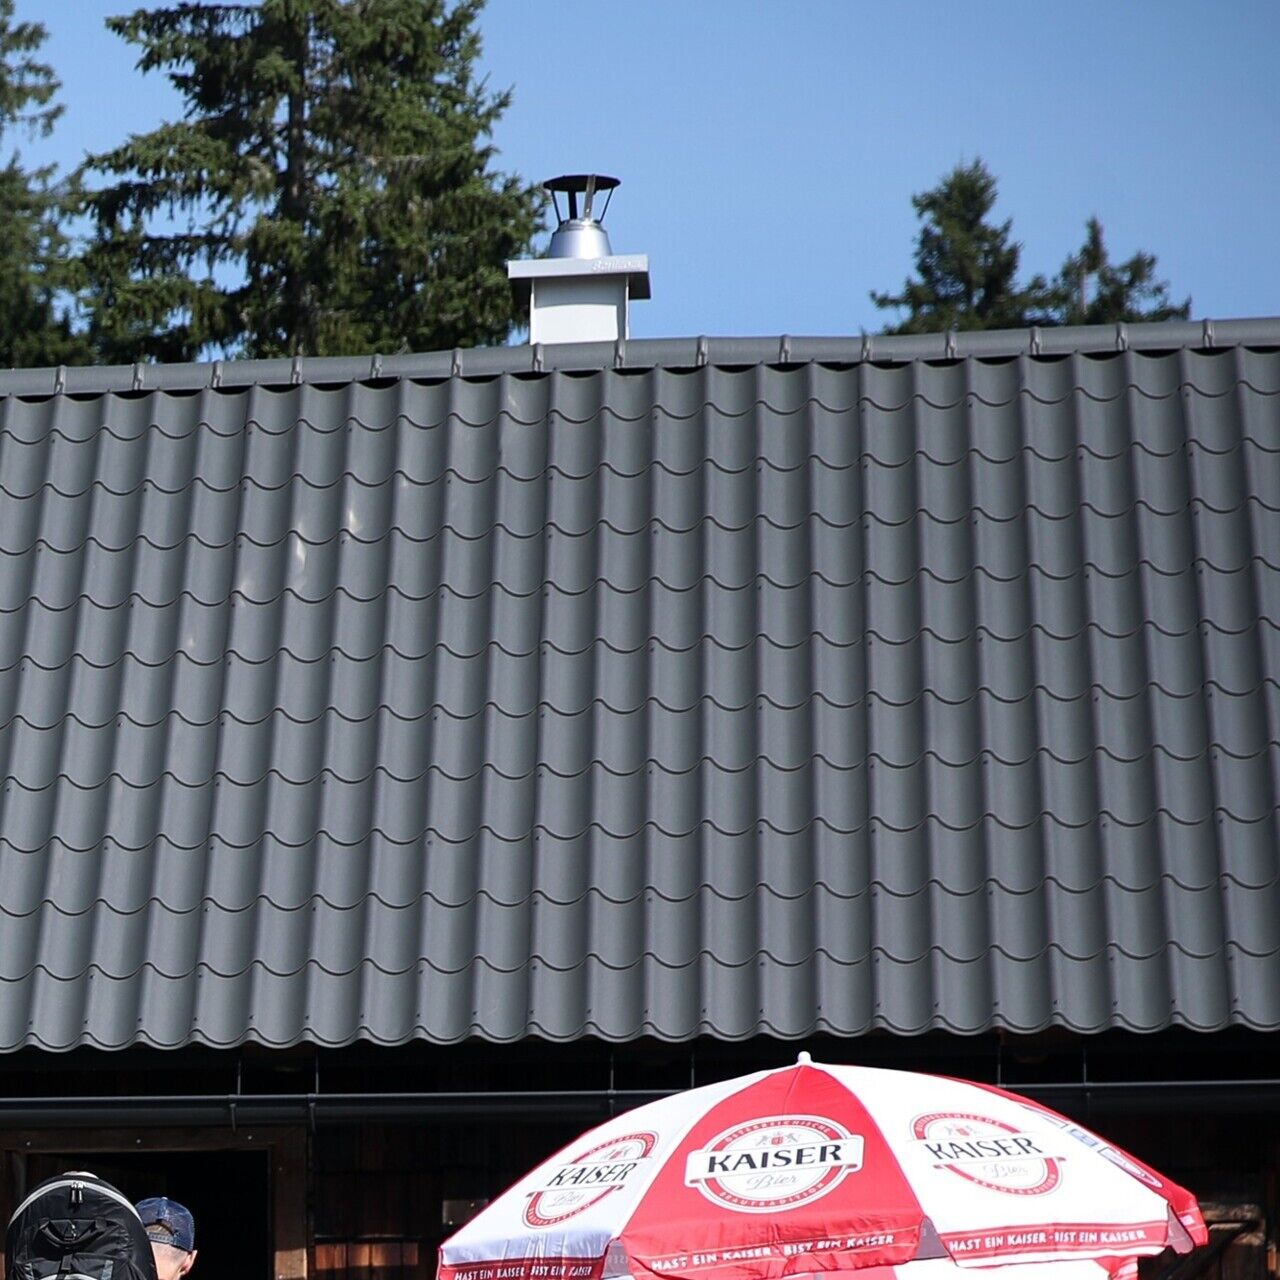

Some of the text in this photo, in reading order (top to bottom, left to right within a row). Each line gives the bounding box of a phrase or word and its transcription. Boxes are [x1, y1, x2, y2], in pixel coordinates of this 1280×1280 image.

[708, 1144, 842, 1173] KAISER
[925, 1137, 1043, 1160] KAISER
[546, 1162, 638, 1187] KAISER
[746, 1174, 800, 1191] Bier
[949, 1238, 981, 1251] HAST
[985, 1236, 1003, 1248] EIN
[1007, 1232, 1046, 1245] KAISER
[1054, 1231, 1078, 1243] BIST
[1079, 1231, 1097, 1243] EIN
[1101, 1230, 1146, 1243] KAISER
[651, 1257, 688, 1271] HAST
[693, 1253, 717, 1266] EIN
[722, 1247, 771, 1261] KAISER
[783, 1242, 813, 1256] BIST
[817, 1240, 841, 1250] EIN
[846, 1235, 894, 1249] KAISER
[480, 1269, 493, 1279] EIN
[497, 1266, 525, 1277] KAISER
[531, 1266, 550, 1276] BIST
[551, 1266, 565, 1276] EIN
